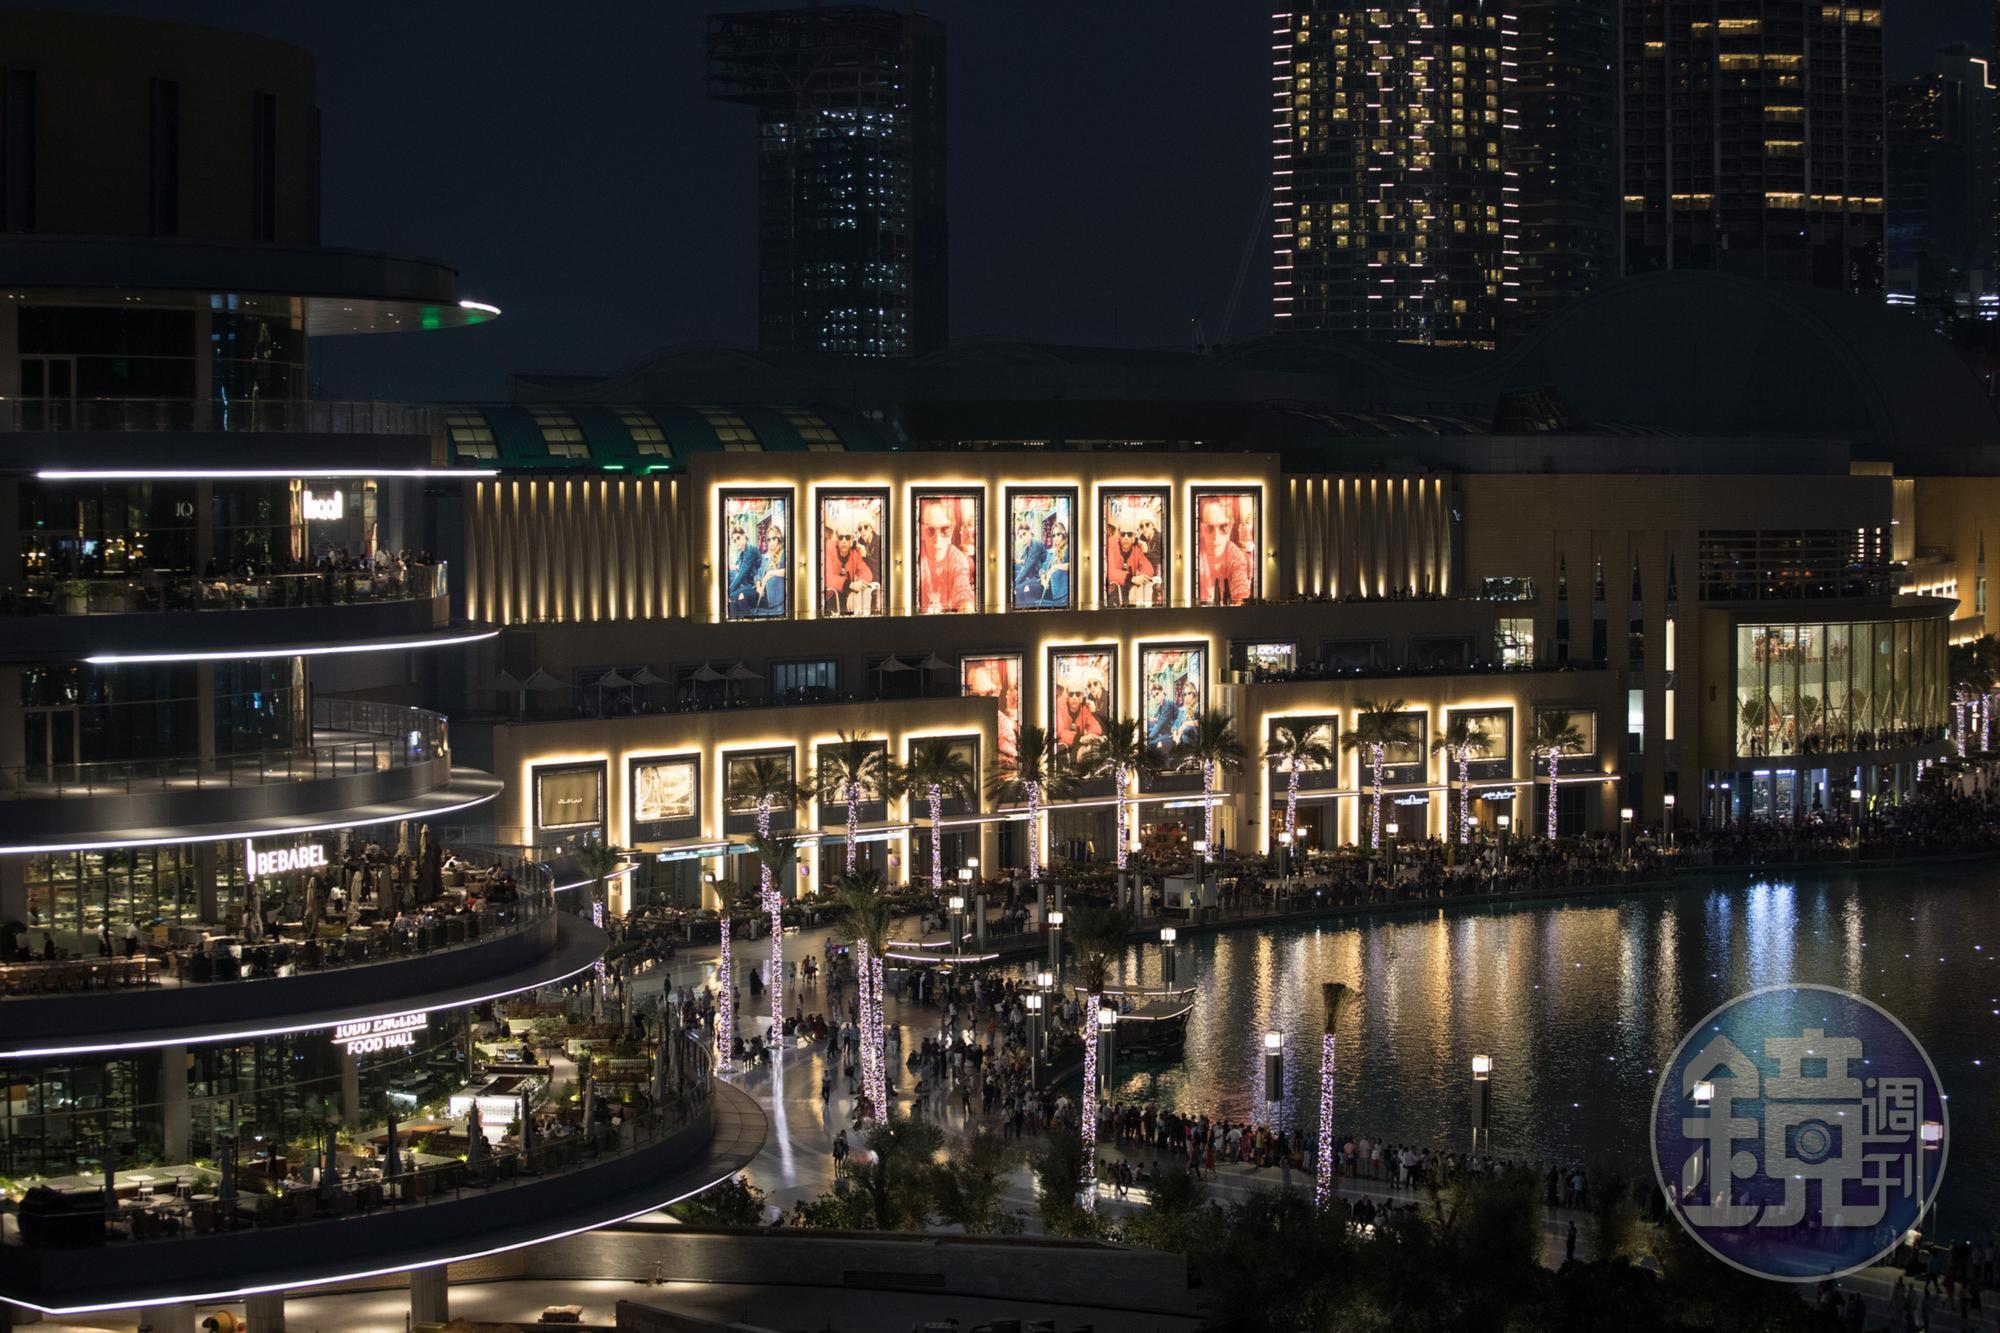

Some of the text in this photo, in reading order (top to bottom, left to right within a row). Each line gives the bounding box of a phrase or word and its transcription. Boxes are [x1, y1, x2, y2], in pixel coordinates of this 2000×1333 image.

[257, 845, 329, 875] BEBABEL
[372, 1013, 427, 1033] ENGLISH
[347, 1031, 415, 1055] FOOD HALL
